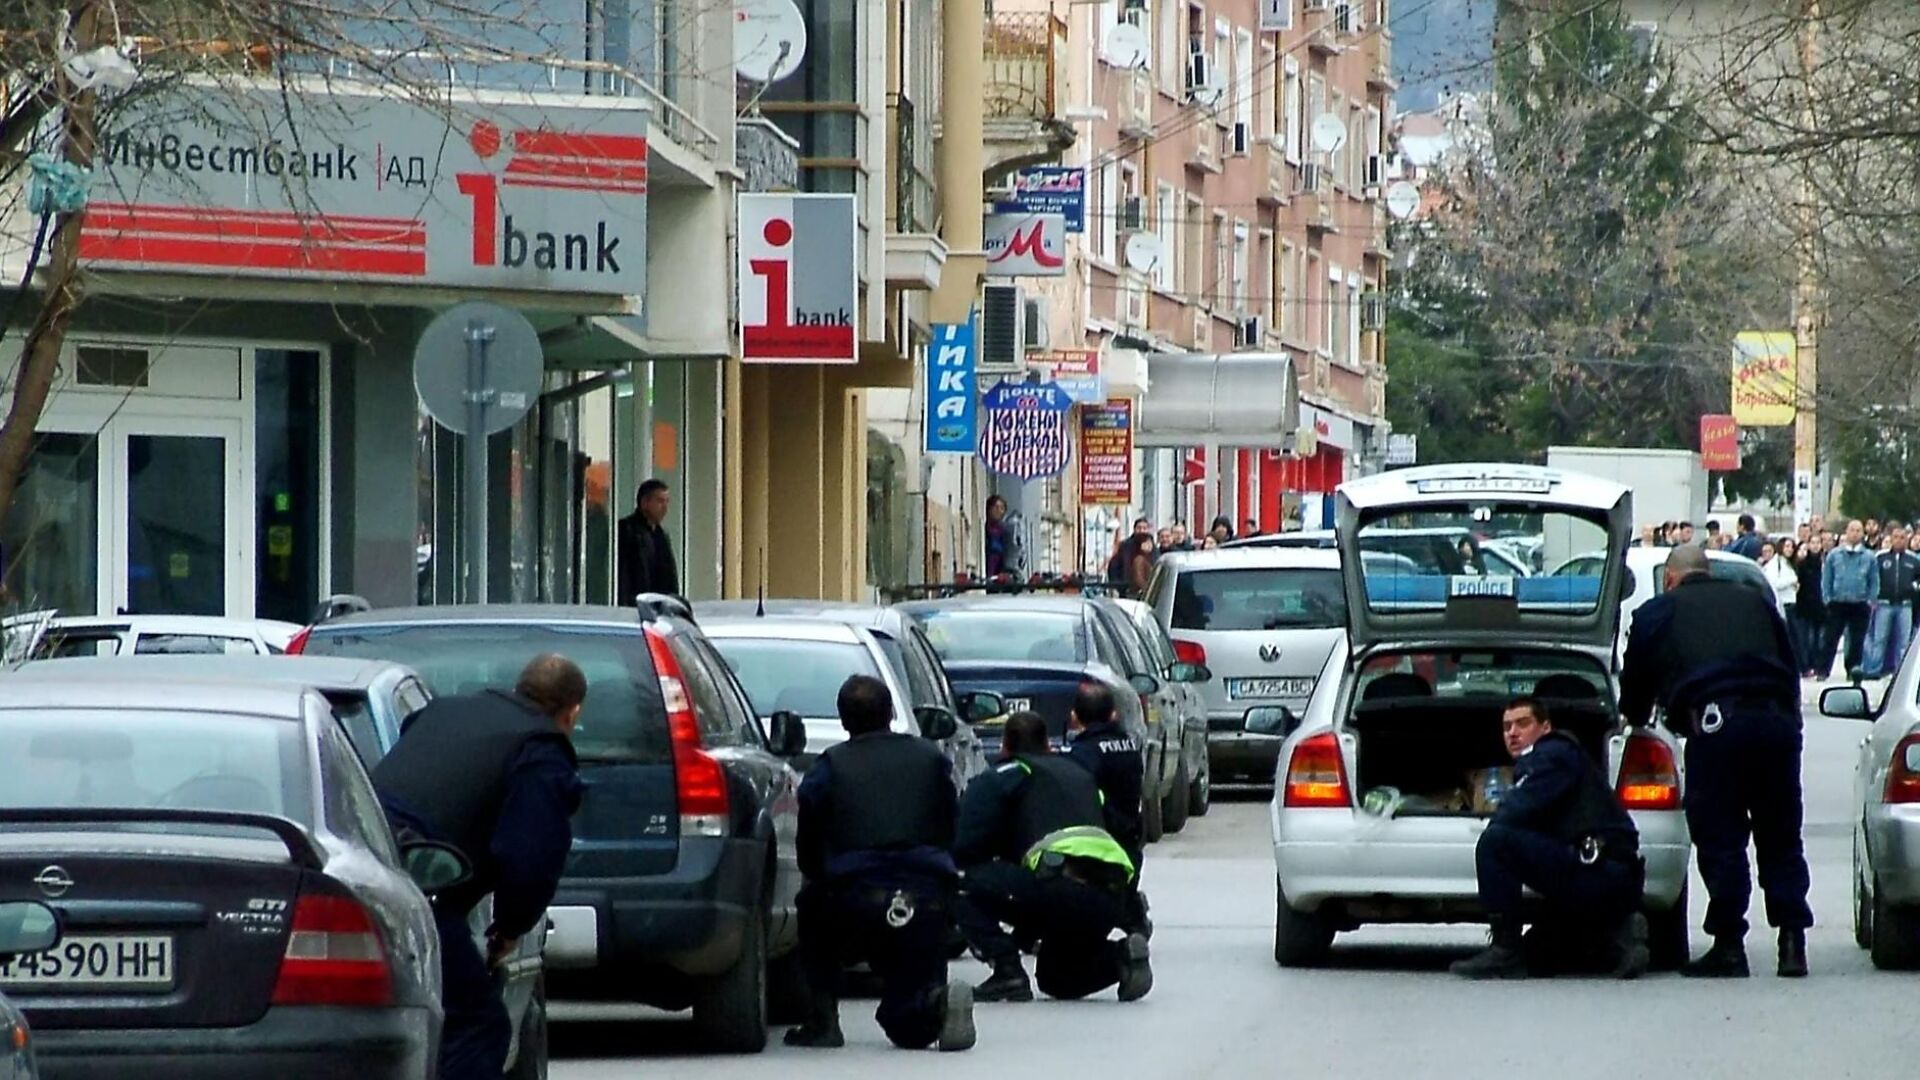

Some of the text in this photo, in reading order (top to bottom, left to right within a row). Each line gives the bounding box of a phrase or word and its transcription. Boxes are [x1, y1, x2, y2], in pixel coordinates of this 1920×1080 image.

[385, 157, 427, 187] АД
[999, 387, 1056, 405] ROUTE
[992, 411, 1058, 430] КОЖЕНИ
[991, 430, 1060, 461] ОБЛЕКЛА
[1458, 582, 1508, 595] POLICE
[216, 911, 283, 923] VECTRA
[117, 942, 165, 976] HH
